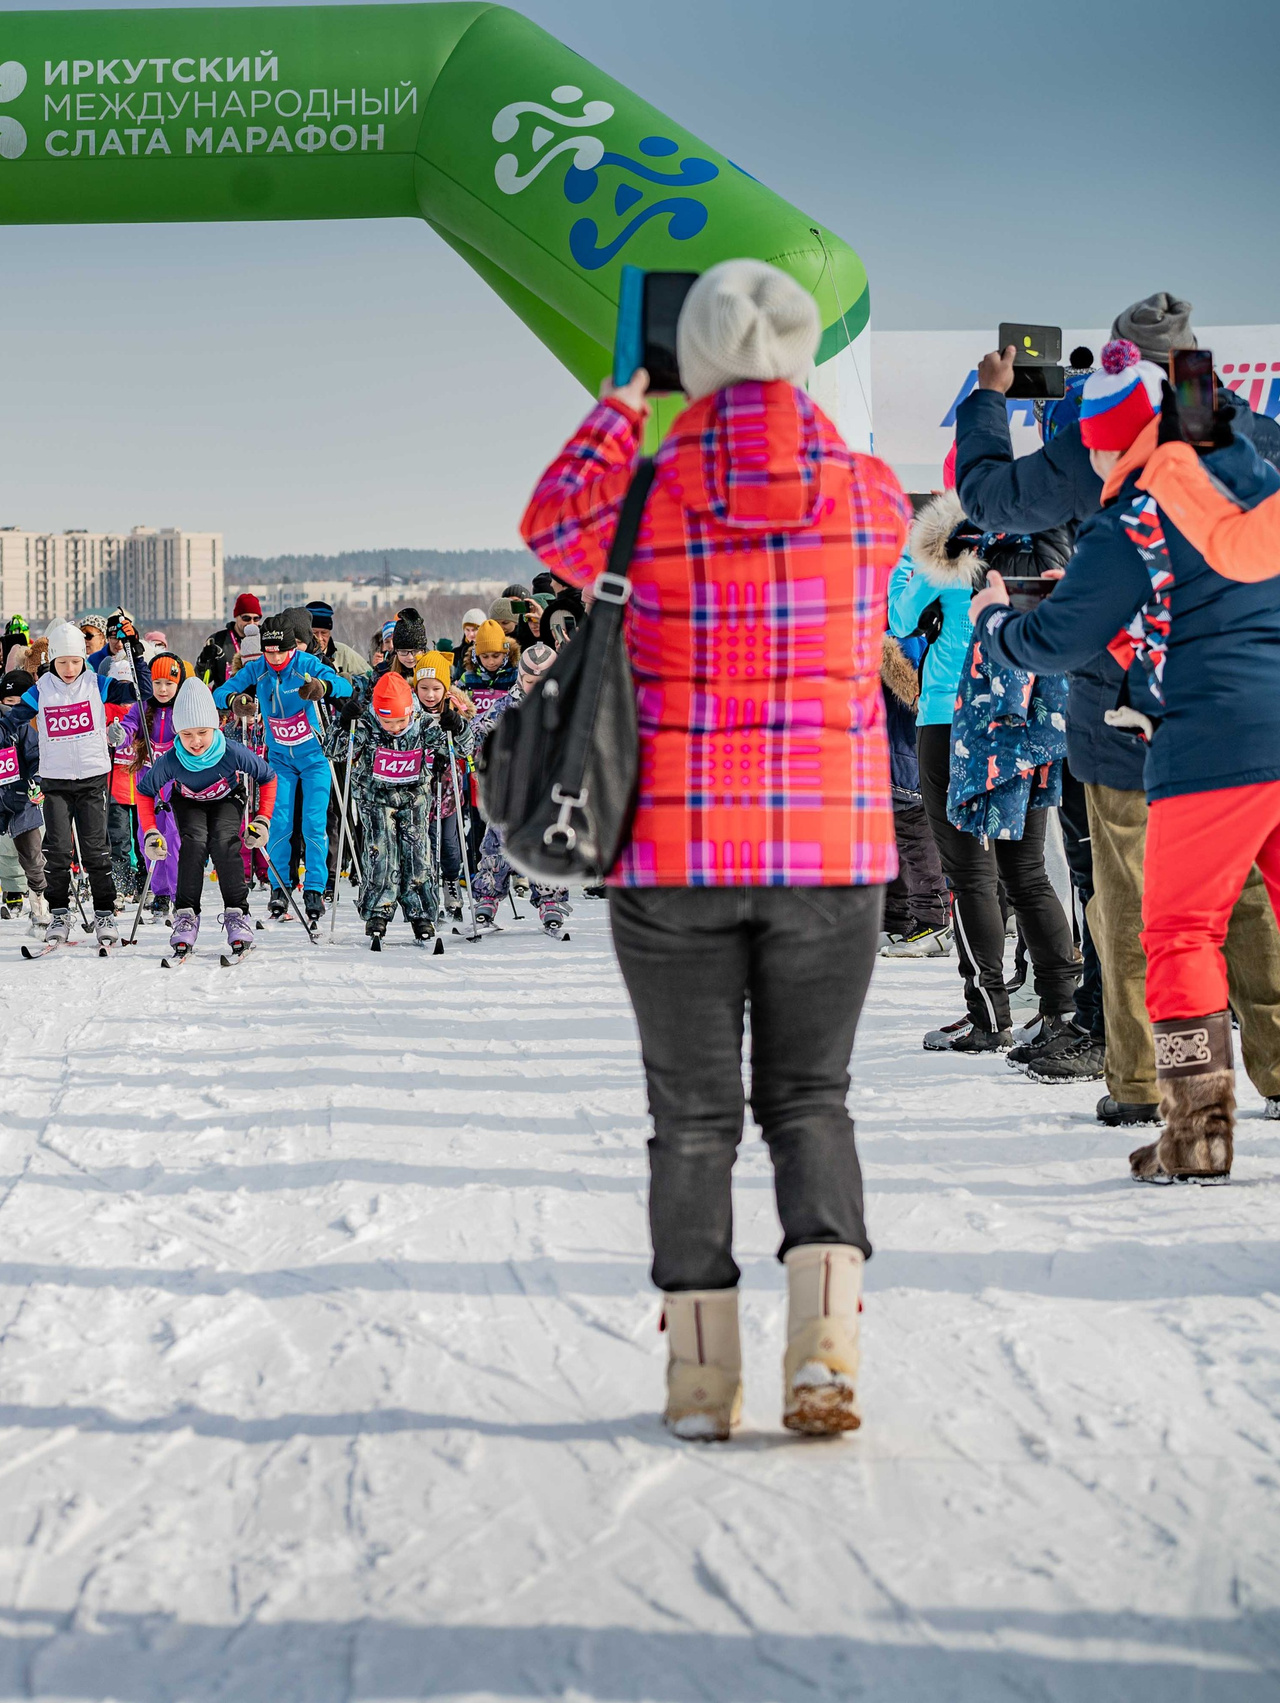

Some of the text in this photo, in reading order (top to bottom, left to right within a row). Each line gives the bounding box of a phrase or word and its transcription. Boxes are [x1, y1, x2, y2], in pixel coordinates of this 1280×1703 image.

[44, 50, 279, 85] ИРКУТСКИЙ
[44, 80, 417, 125] МЕЖДУНАРОДНЫЙ
[44, 124, 385, 157] СЛАТА МАРАФОН
[474, 697, 497, 710] 201
[48, 712, 90, 732] 2036
[273, 720, 307, 738] 1028
[379, 758, 416, 773] 1474
